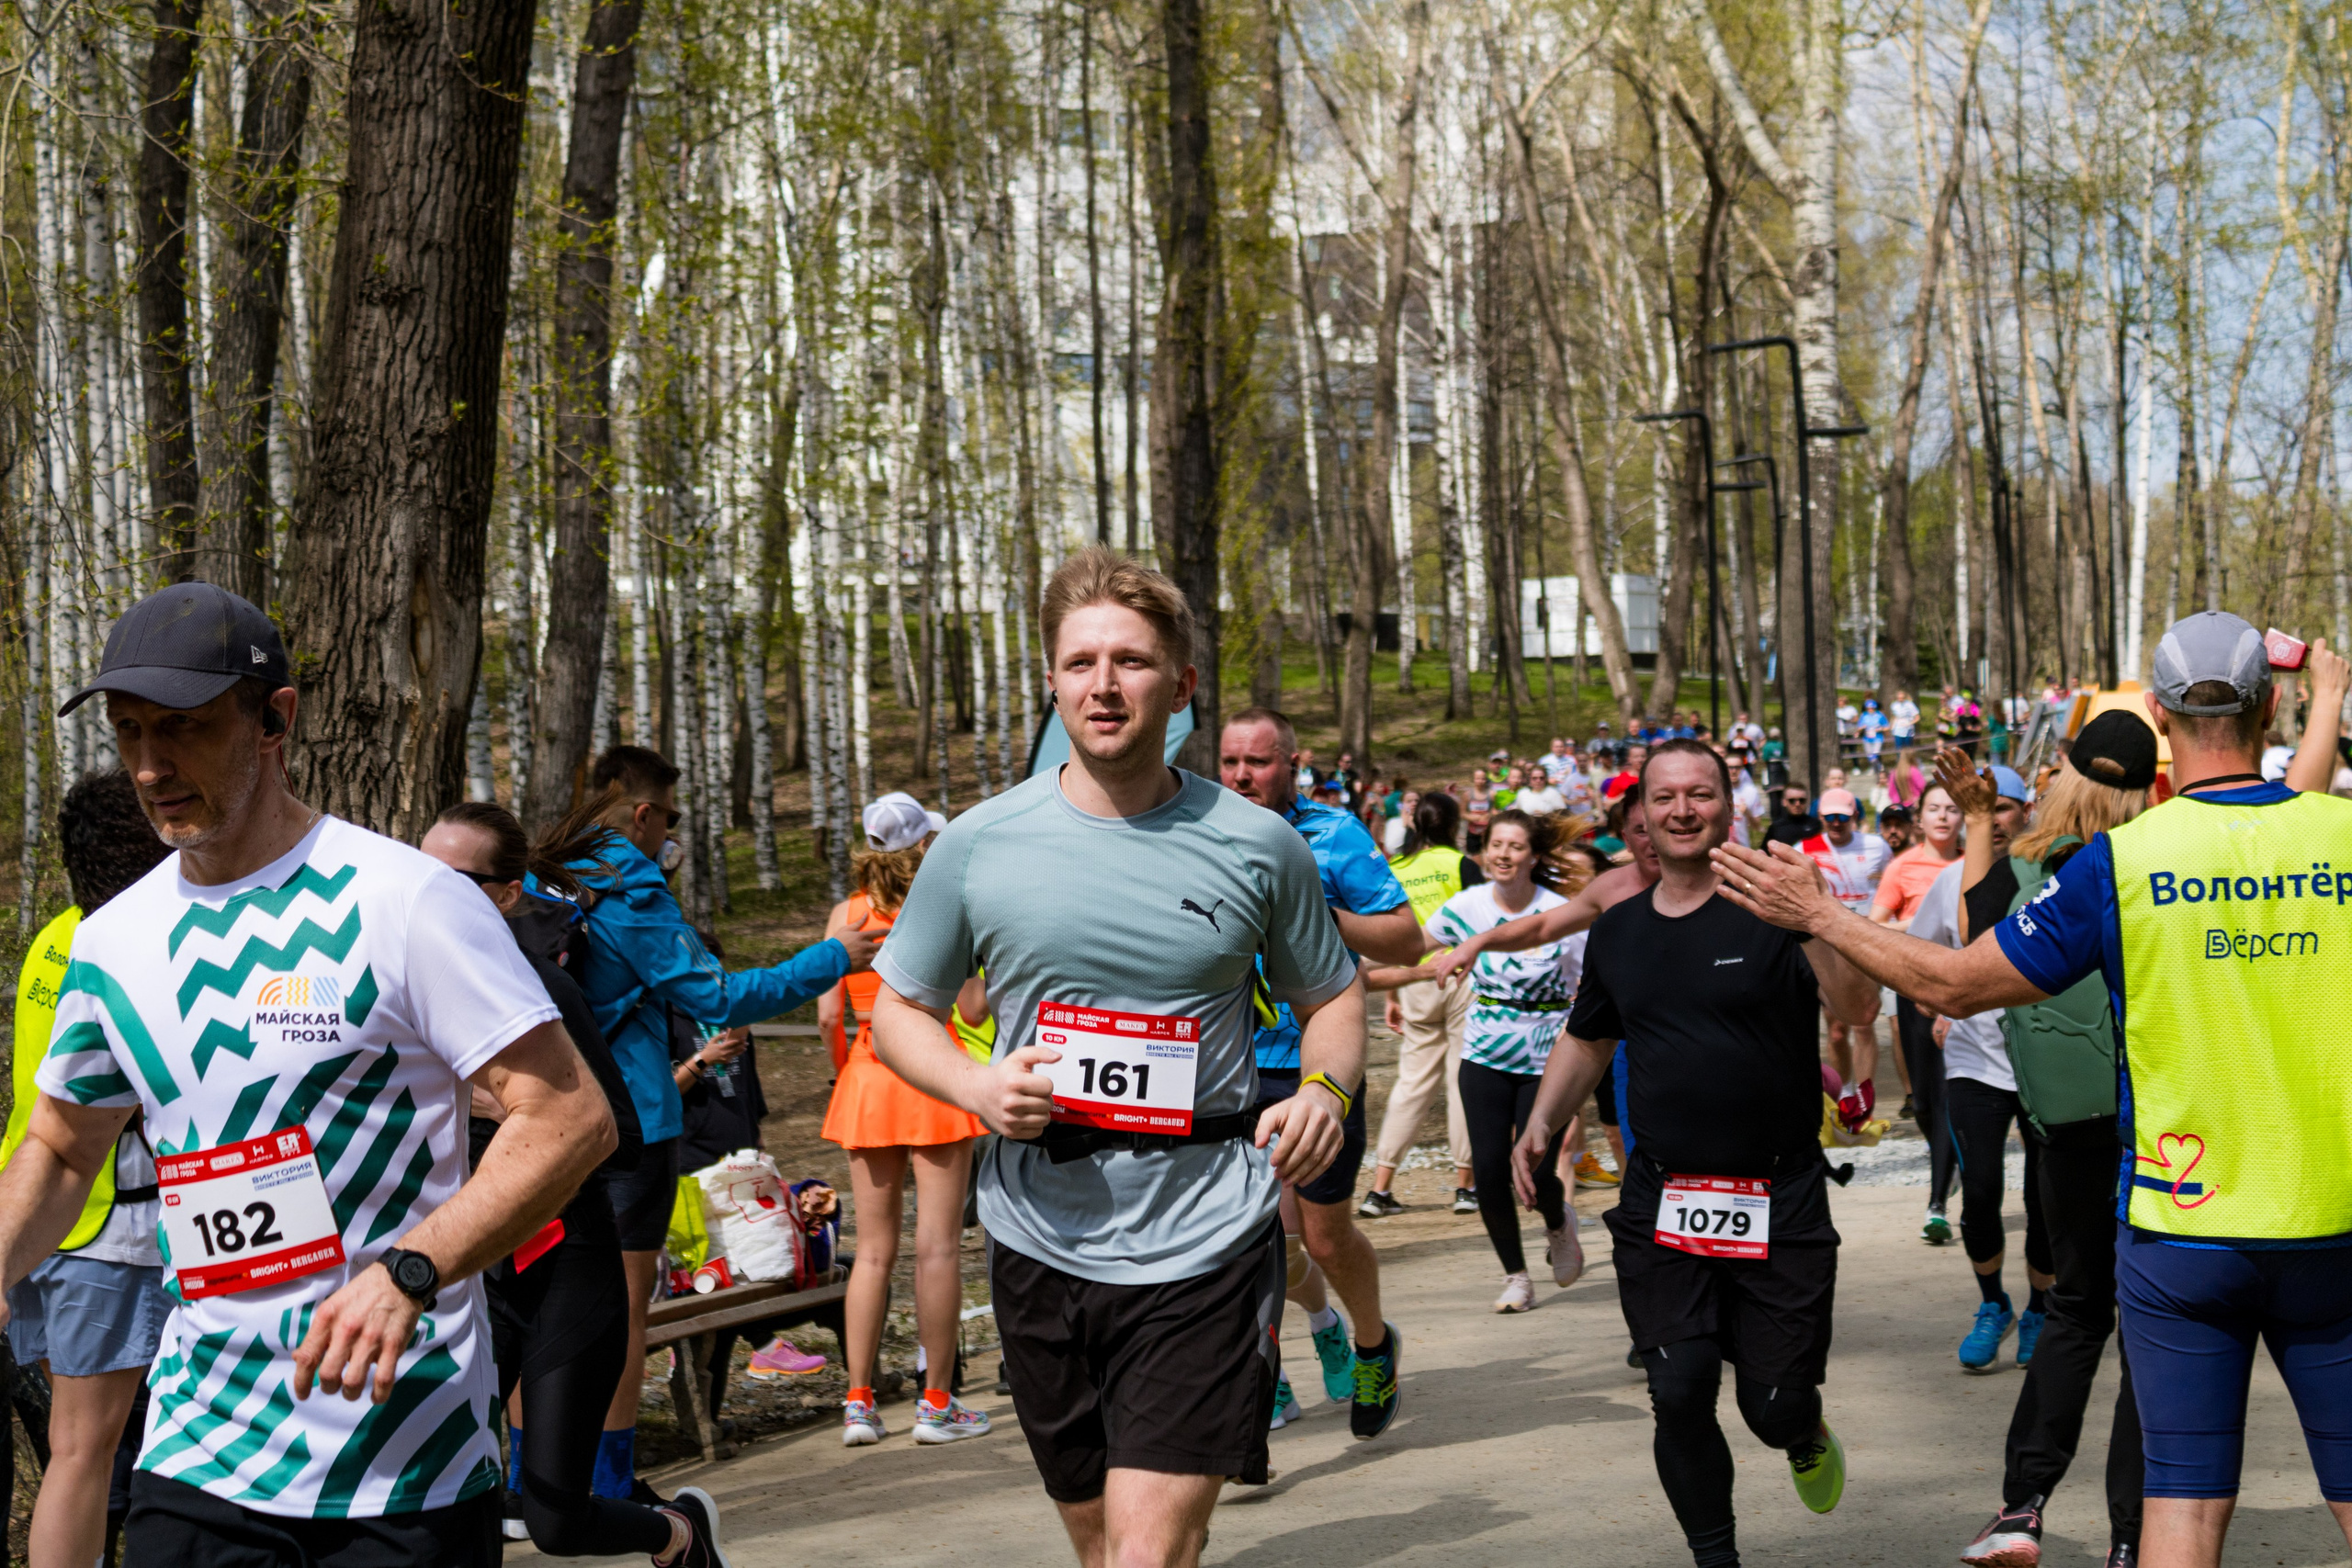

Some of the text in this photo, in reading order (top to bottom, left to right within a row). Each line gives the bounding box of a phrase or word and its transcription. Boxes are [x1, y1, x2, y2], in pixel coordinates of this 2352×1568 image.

[2149, 862, 2352, 907] Волонтёр
[255, 1009, 341, 1026] МАЙСКАЯ
[1077, 1012, 1110, 1023] МАЙСКАЯ
[1077, 1021, 1098, 1029] ГРОЗА
[1118, 1021, 1146, 1031] MAKFA
[282, 1030, 342, 1043] ГРОЗА
[1146, 1043, 1195, 1055] ВИКТОРИЯ
[1079, 1058, 1150, 1100] 161
[1149, 1116, 1186, 1128] BERGAUER
[252, 1161, 313, 1186] ВИКТОРИЯ
[192, 1201, 284, 1258] 182
[1677, 1207, 1751, 1237] 1079
